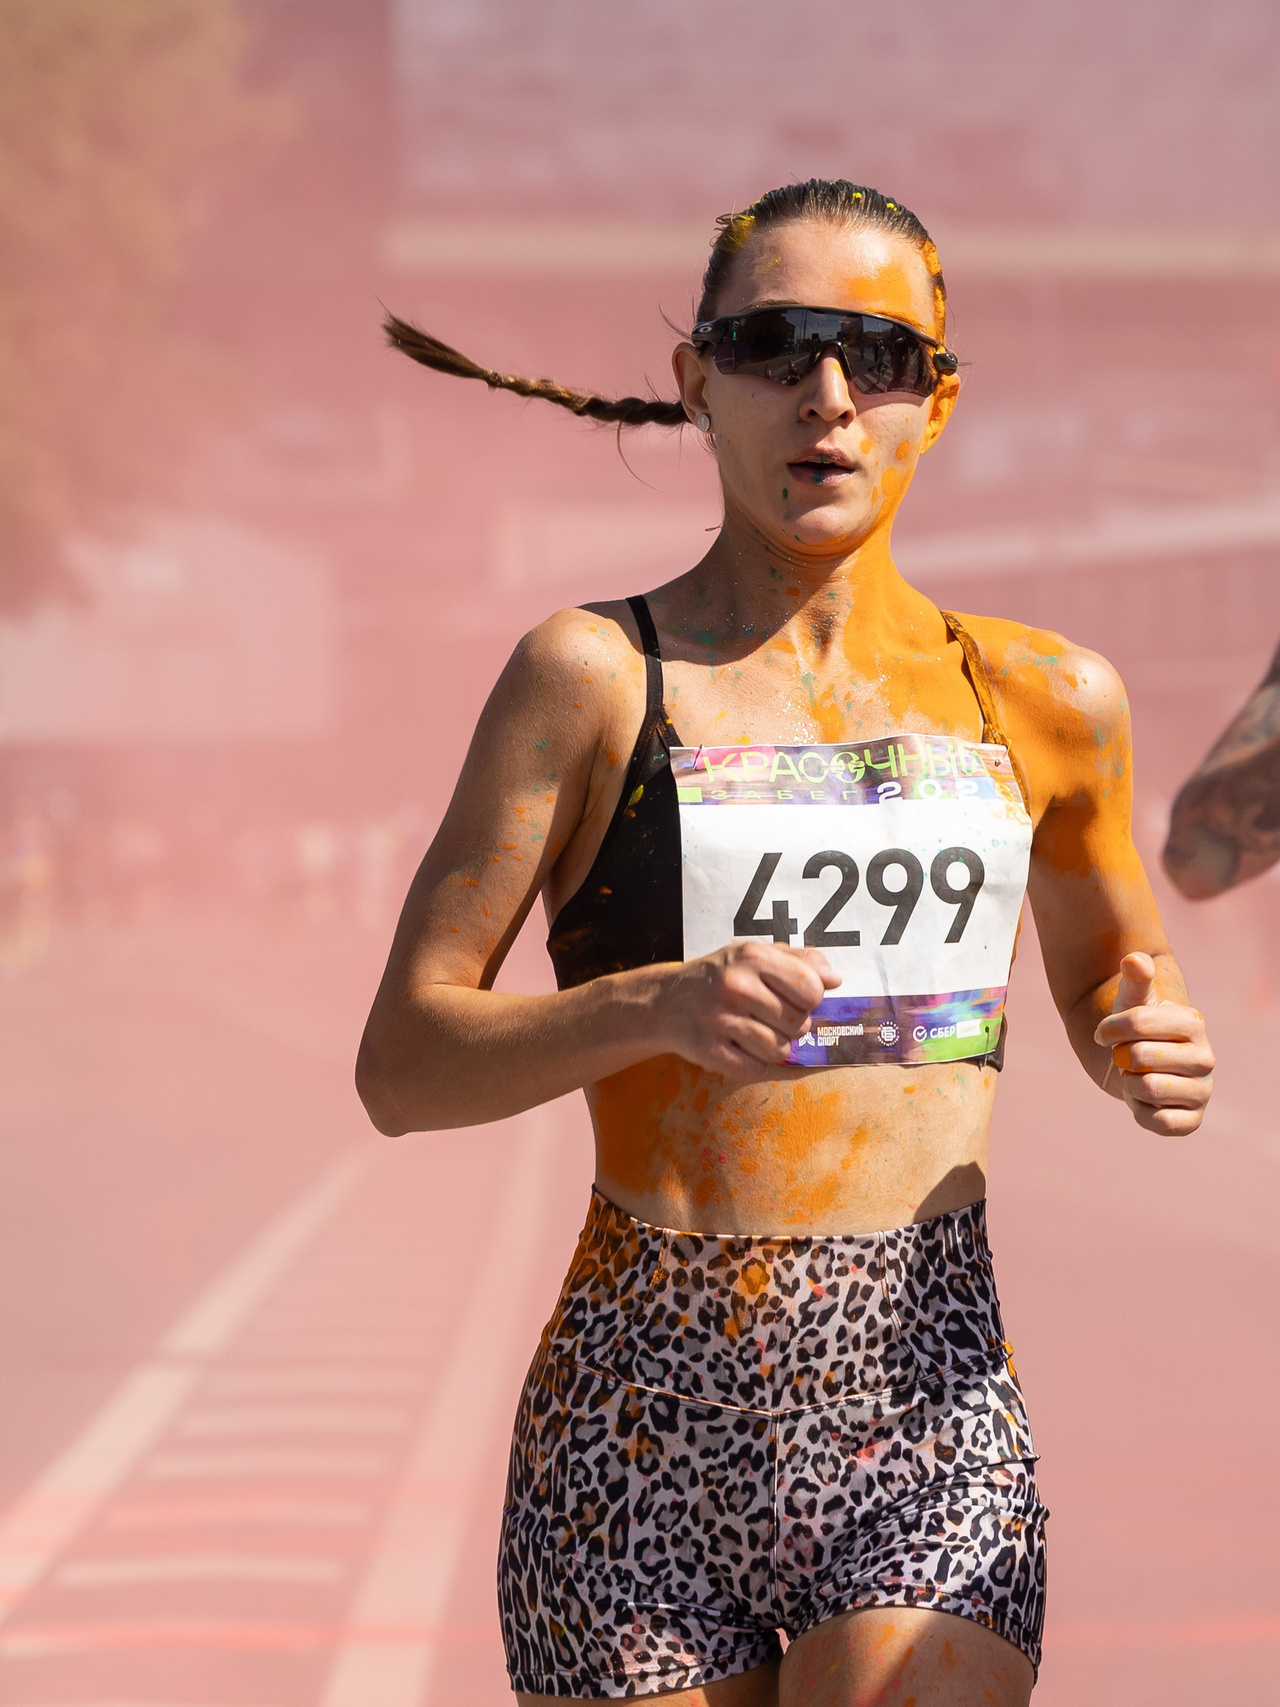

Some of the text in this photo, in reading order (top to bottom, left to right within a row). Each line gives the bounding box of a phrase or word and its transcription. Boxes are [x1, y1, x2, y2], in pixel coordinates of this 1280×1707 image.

[710, 789, 860, 801] ЗАБЕГ
[876, 779, 1000, 804] 202
[732, 846, 987, 948] 4299
[816, 1024, 864, 1037] МОСКОВСКИЙ
[929, 1027, 956, 1039] СБЕР
[816, 1036, 840, 1047] СПОРТ
